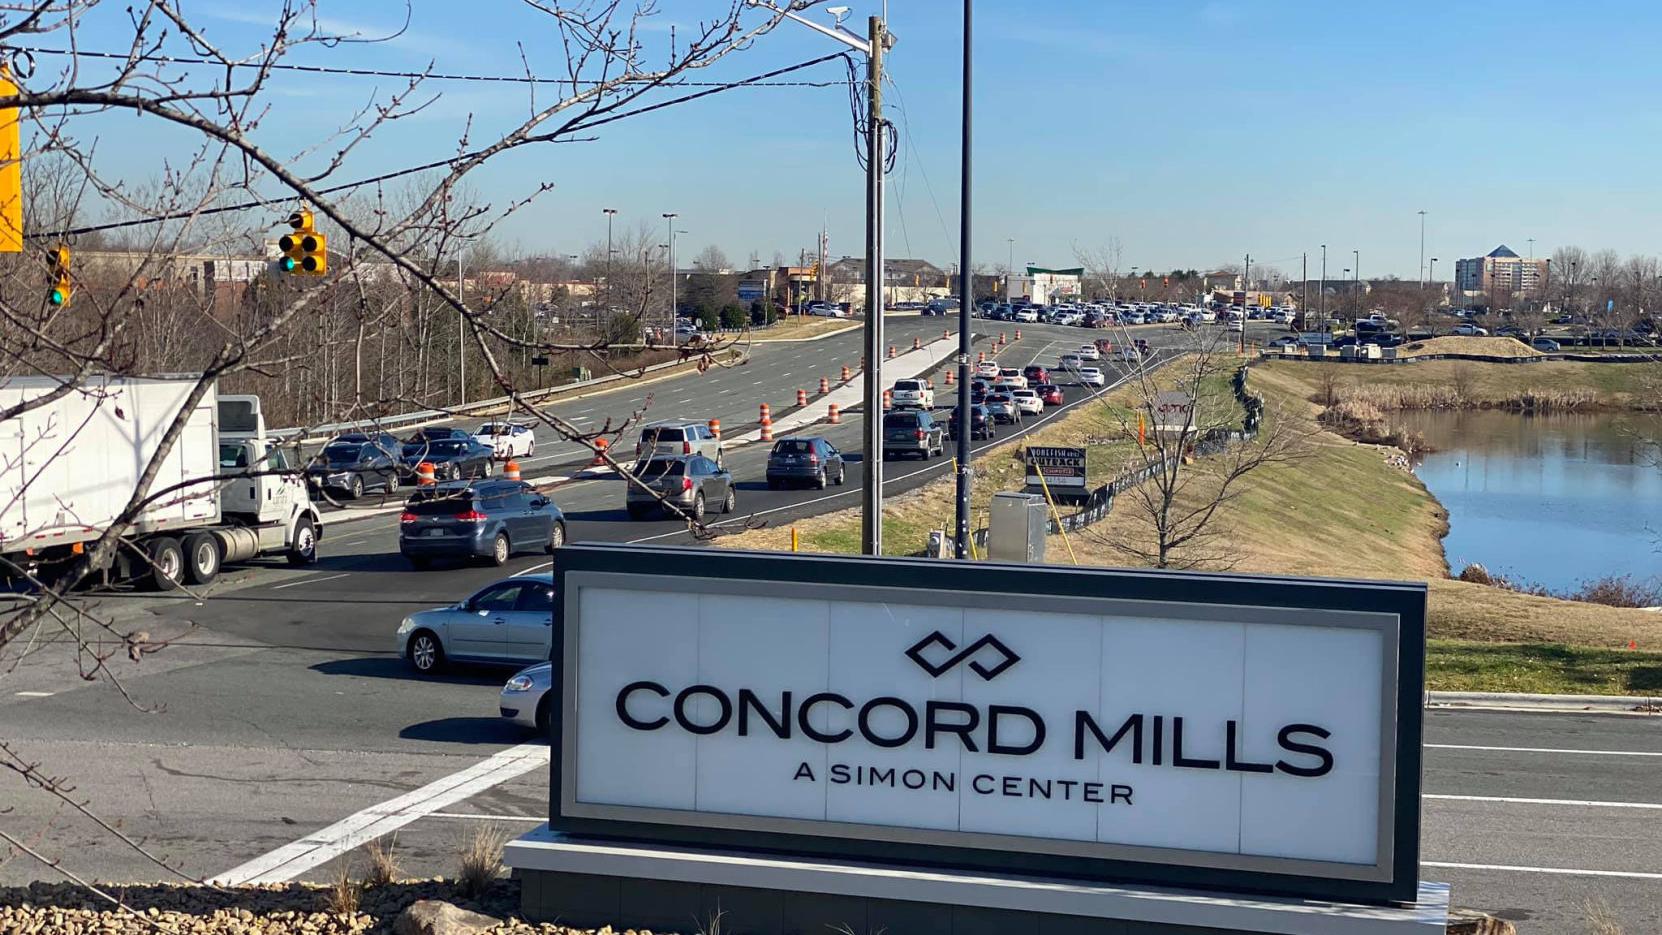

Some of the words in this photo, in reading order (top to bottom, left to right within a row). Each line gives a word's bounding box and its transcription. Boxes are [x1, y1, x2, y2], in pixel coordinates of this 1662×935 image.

[1030, 458, 1080, 466] OUTBACK
[616, 681, 1047, 756] CONCORD
[1075, 710, 1334, 778] MILLS
[794, 761, 816, 782] A
[830, 763, 955, 792] SIMON
[972, 774, 1134, 806] CENTER
